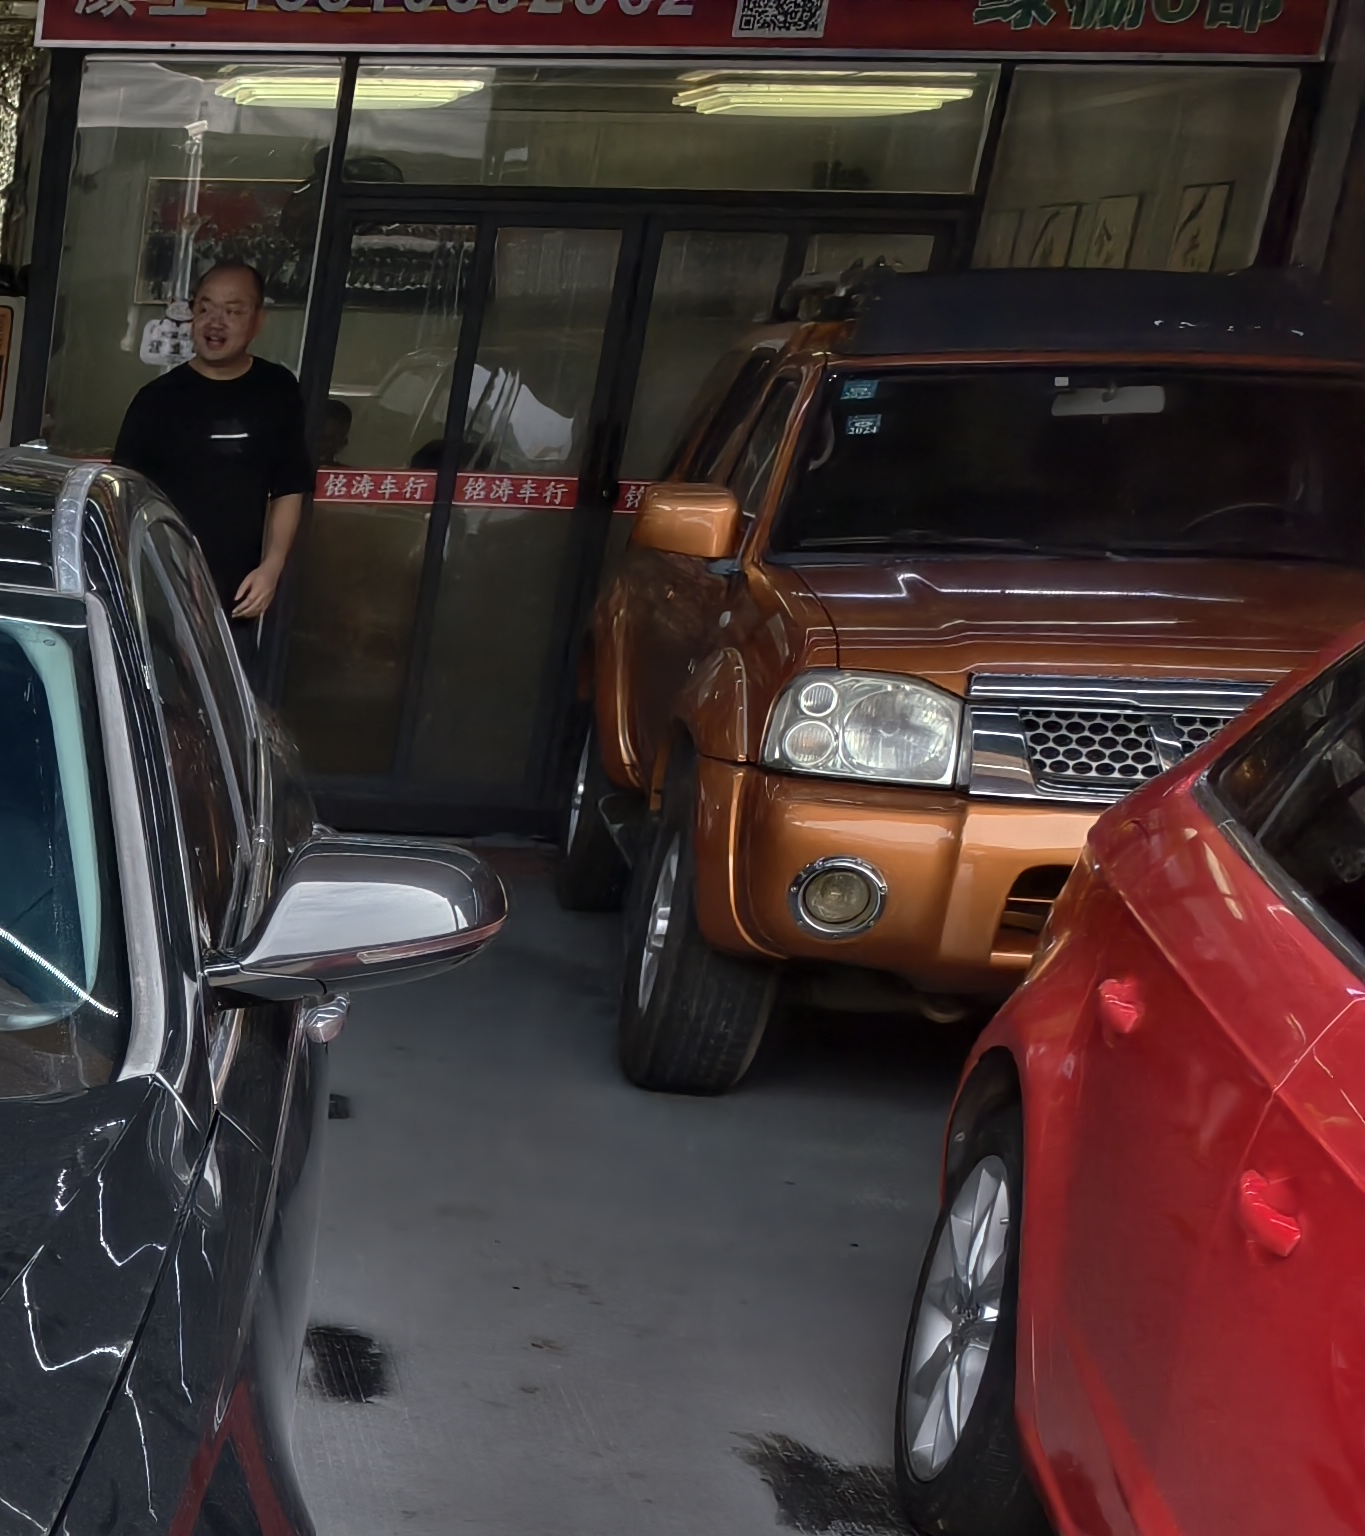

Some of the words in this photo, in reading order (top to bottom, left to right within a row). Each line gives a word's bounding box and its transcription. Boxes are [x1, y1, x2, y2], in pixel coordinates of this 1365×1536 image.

[324, 473, 429, 500] 铭涛车行
[462, 477, 569, 505] 铭涛车行
